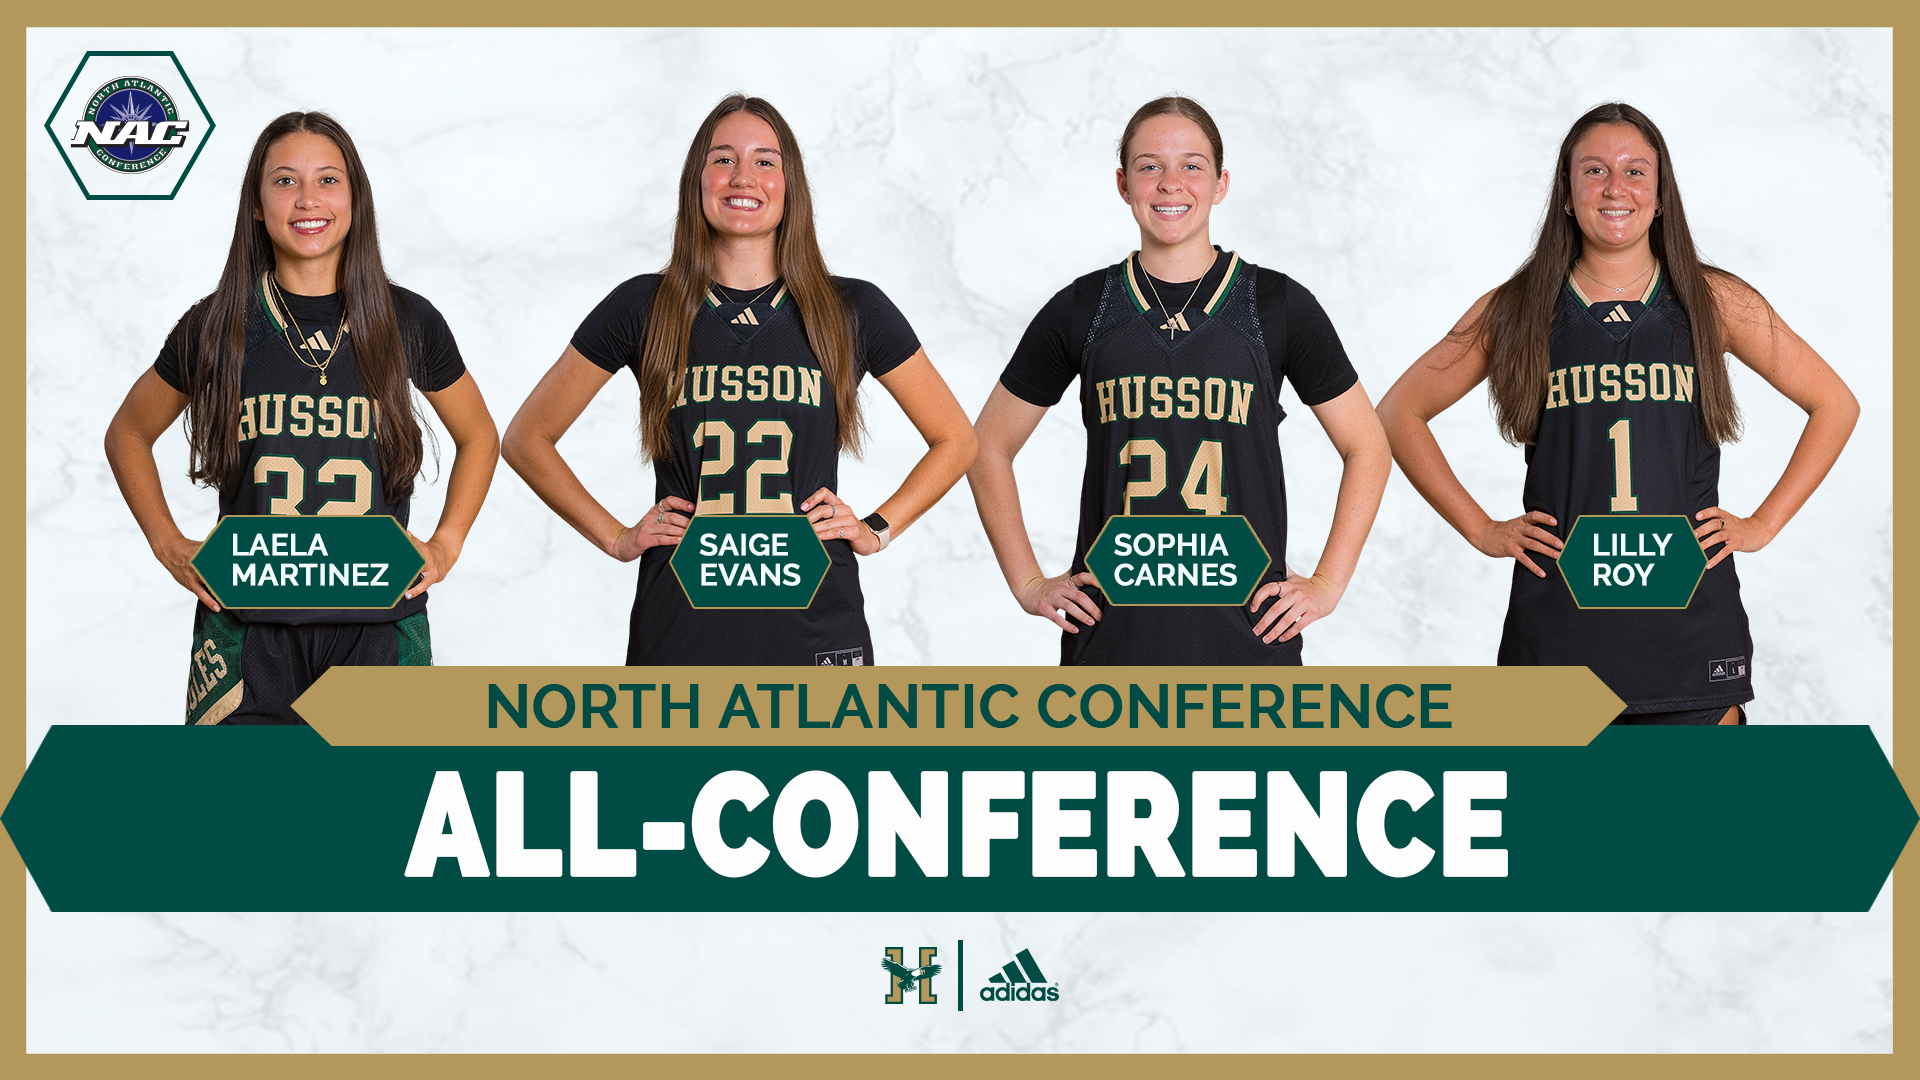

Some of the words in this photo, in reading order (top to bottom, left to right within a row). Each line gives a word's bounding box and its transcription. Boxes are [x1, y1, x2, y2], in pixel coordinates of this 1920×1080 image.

[1096, 374, 1254, 426] HUSSON
[1546, 362, 1695, 410] HUSSON
[253, 454, 375, 515] 32
[691, 418, 796, 515] 22
[1117, 437, 1230, 515] 24
[1606, 417, 1640, 514] 1
